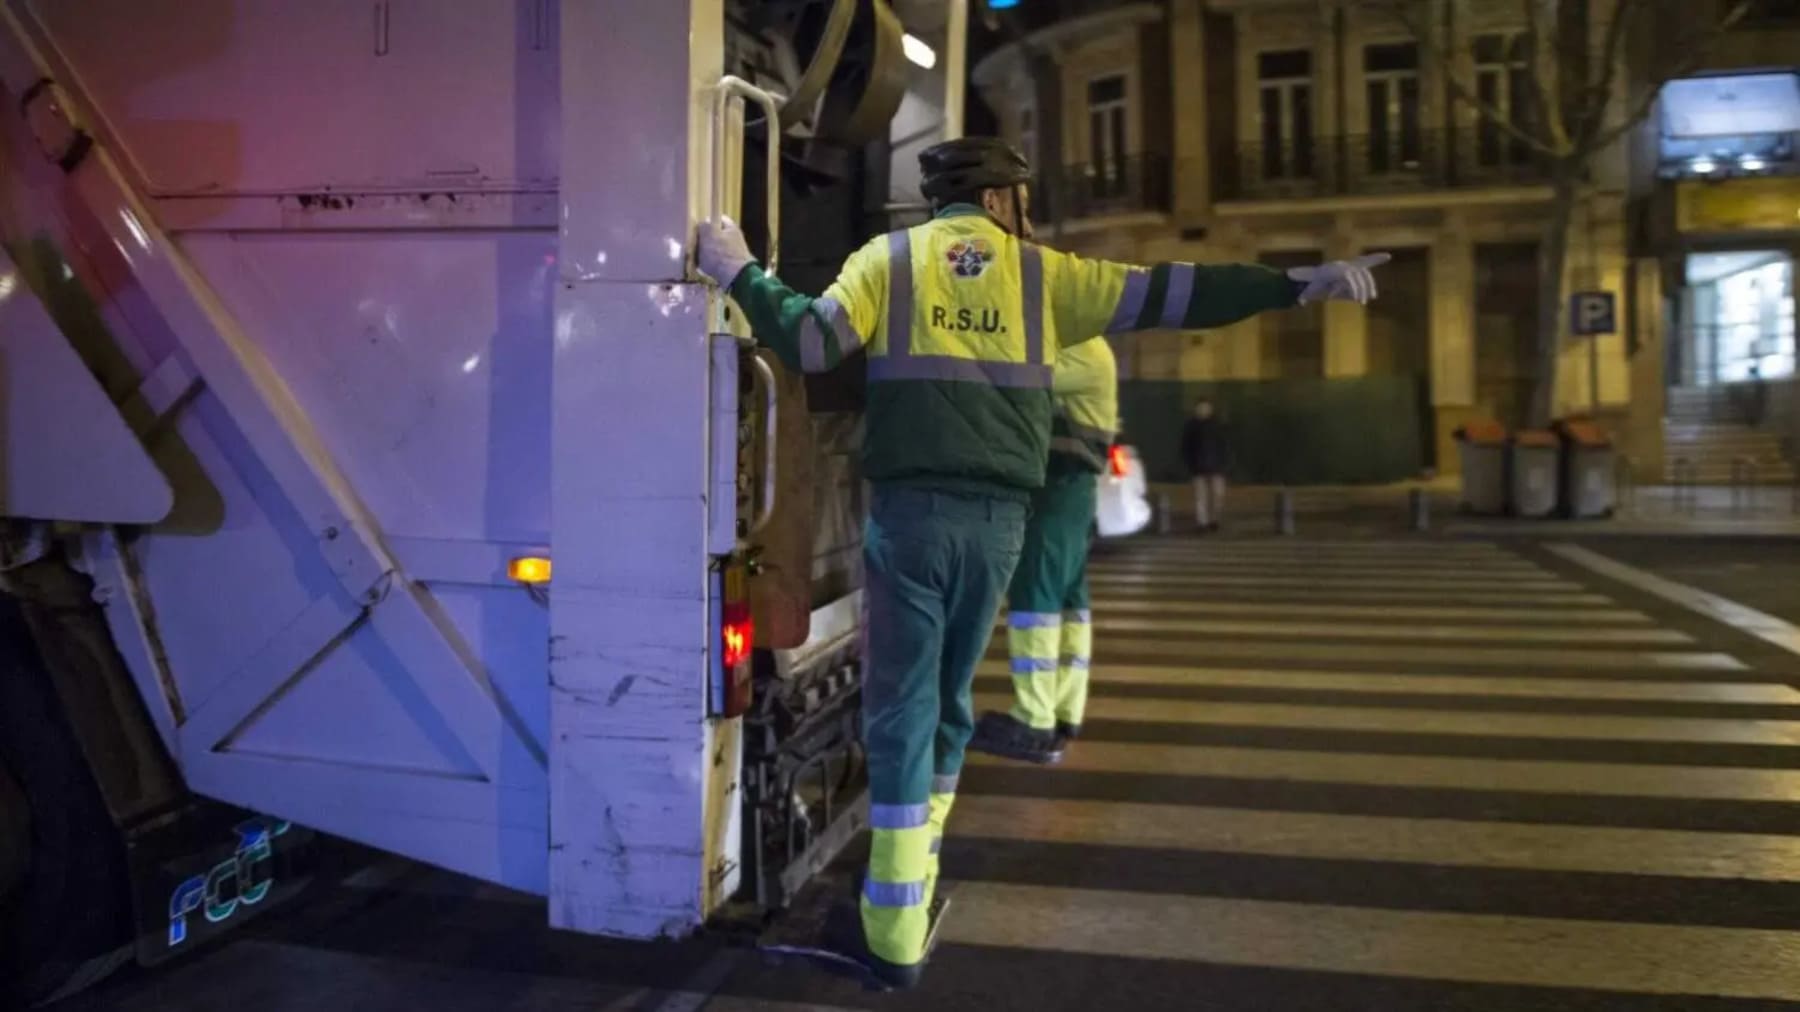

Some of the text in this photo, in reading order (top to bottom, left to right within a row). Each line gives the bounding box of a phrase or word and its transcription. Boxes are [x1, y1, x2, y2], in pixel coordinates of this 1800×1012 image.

[931, 305, 1007, 333] R.S.U.
[1580, 297, 1609, 330] P
[168, 842, 272, 947] FCC
